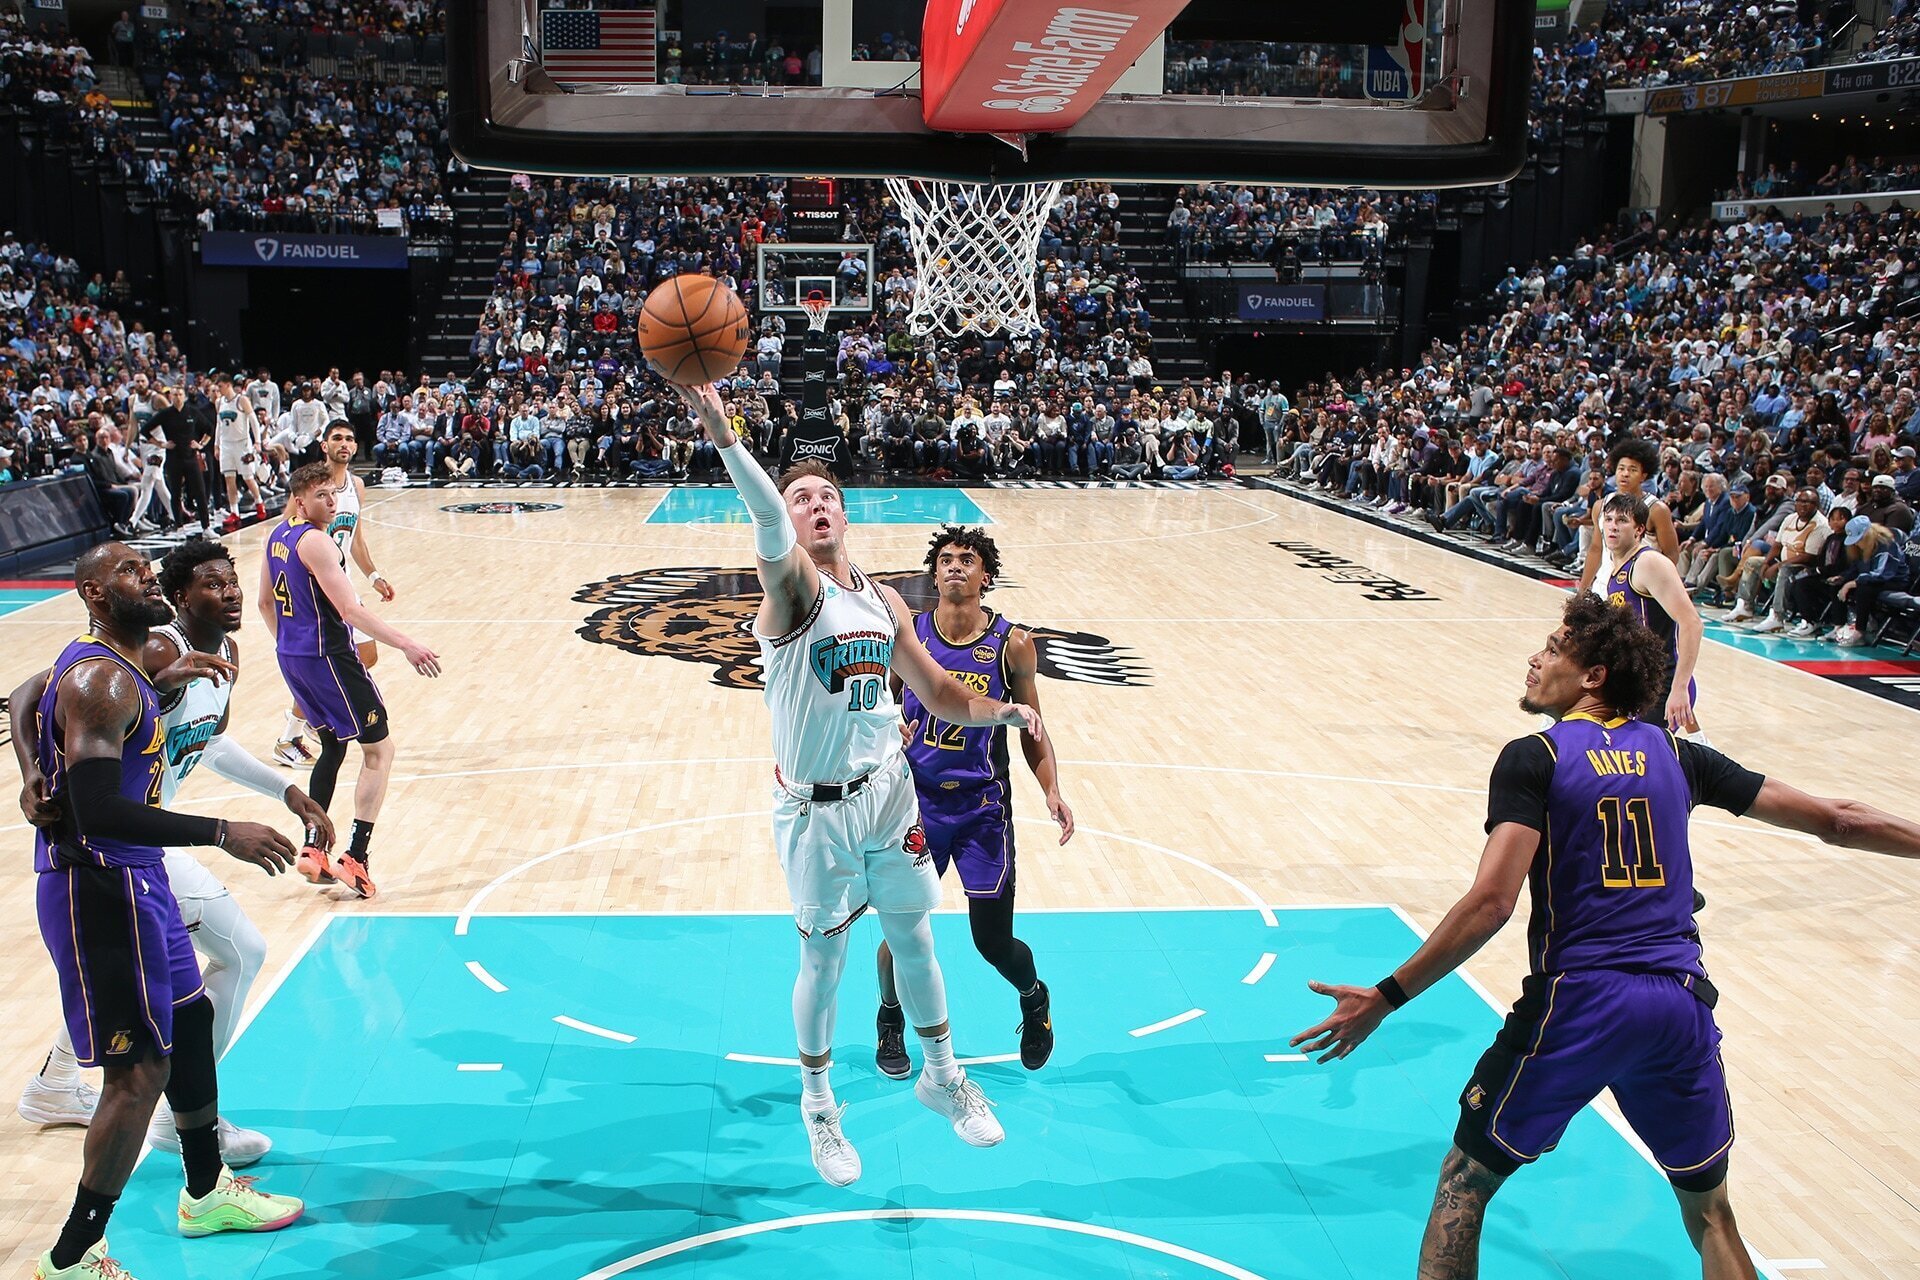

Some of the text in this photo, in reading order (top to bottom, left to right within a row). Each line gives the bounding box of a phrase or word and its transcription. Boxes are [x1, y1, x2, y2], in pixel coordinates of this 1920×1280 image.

[148, 8, 163, 17] 102
[1373, 70, 1401, 92] NBA
[1758, 74, 1808, 90] TIMEOUTS
[1832, 73, 1852, 89] 4TH
[1704, 83, 1735, 106] 87
[1756, 88, 1800, 101] FOULS 3
[818, 181, 833, 205] 7
[805, 211, 839, 219] TISSOT
[1726, 205, 1739, 216] 116
[283, 243, 360, 259] FANDUEL
[1264, 298, 1315, 307] FANDUEL
[797, 444, 833, 455] SONIC
[272, 570, 294, 618] 4
[836, 630, 887, 642] VANCOUVER
[848, 678, 879, 712] 10
[1586, 749, 1646, 777] HAYES
[1596, 796, 1666, 888] 11
